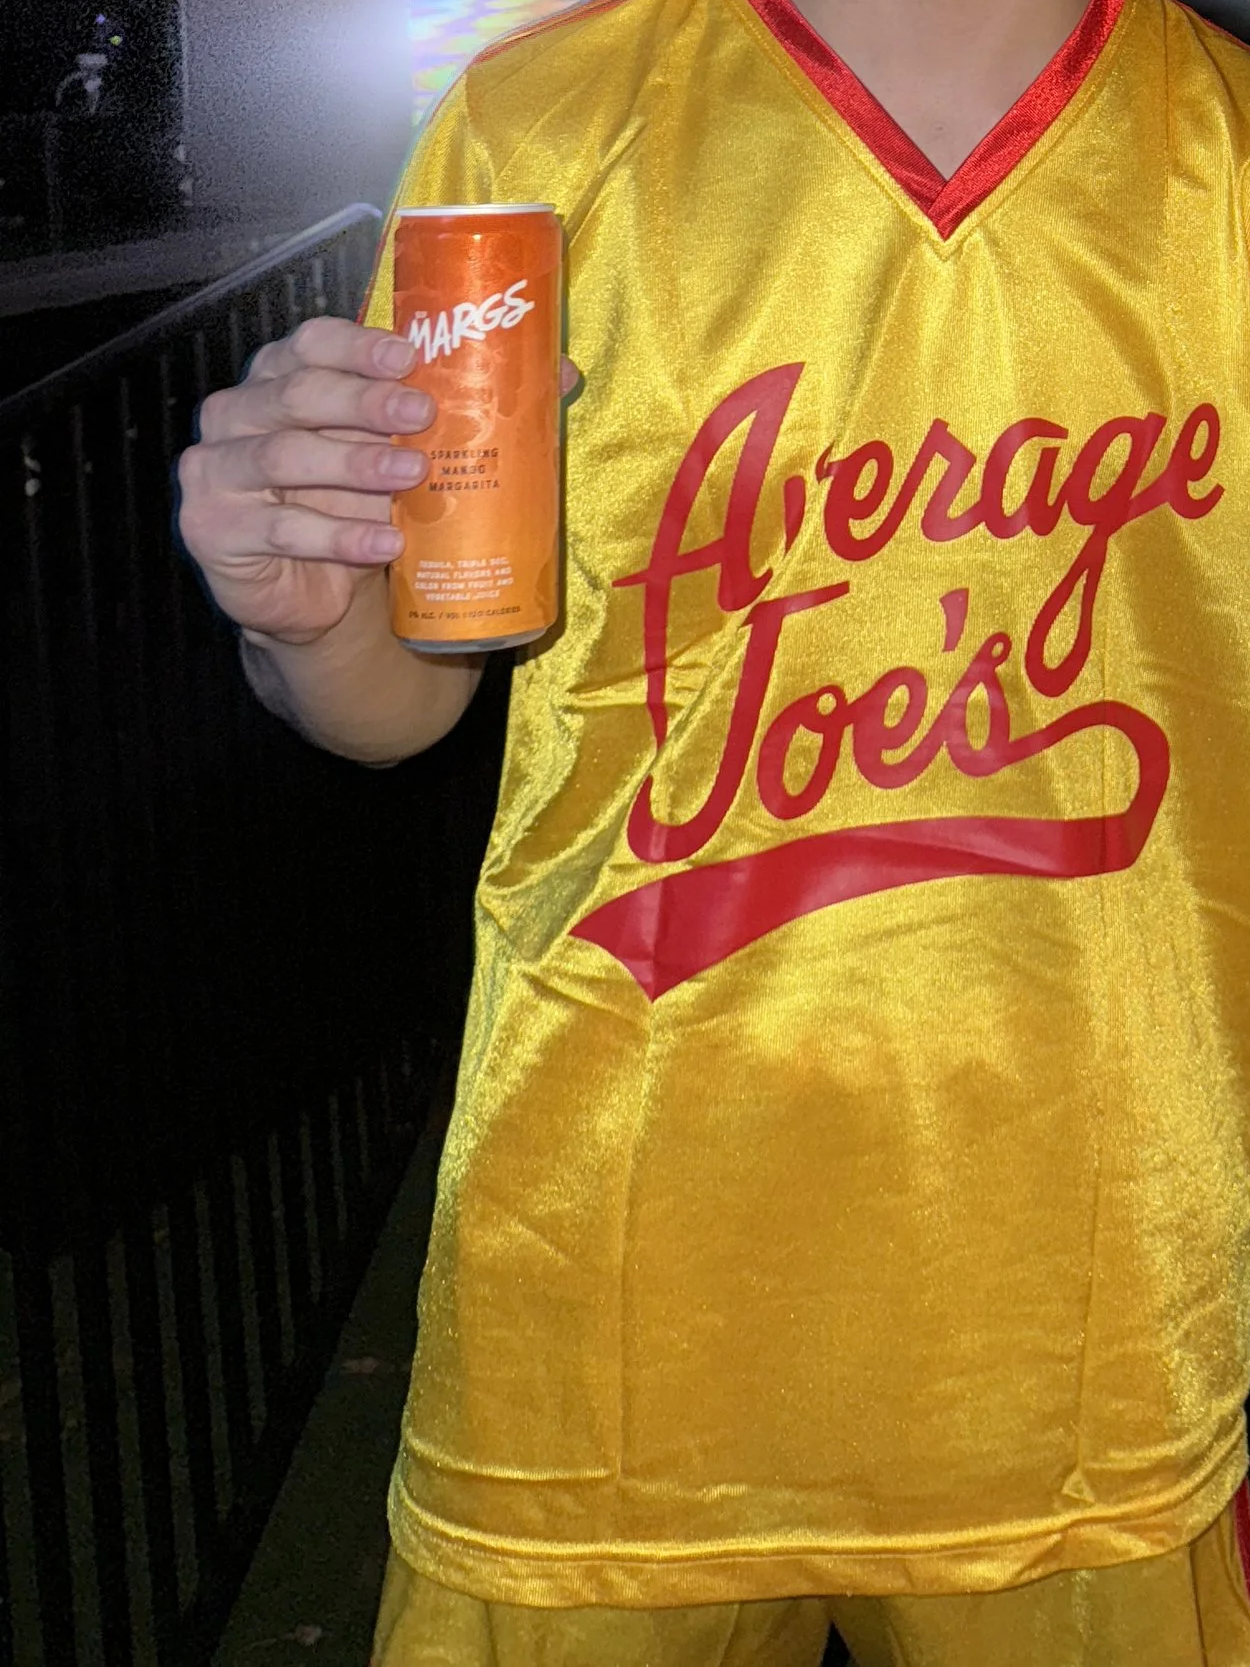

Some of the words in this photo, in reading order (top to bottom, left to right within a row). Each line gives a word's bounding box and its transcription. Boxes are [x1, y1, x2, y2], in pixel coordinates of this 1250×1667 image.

[408, 279, 535, 364] MARGS
[430, 447, 499, 460] SPARKLING
[442, 464, 486, 476] MANGO
[429, 480, 500, 492] MARGARITA
[627, 581, 1014, 864] Joe's
